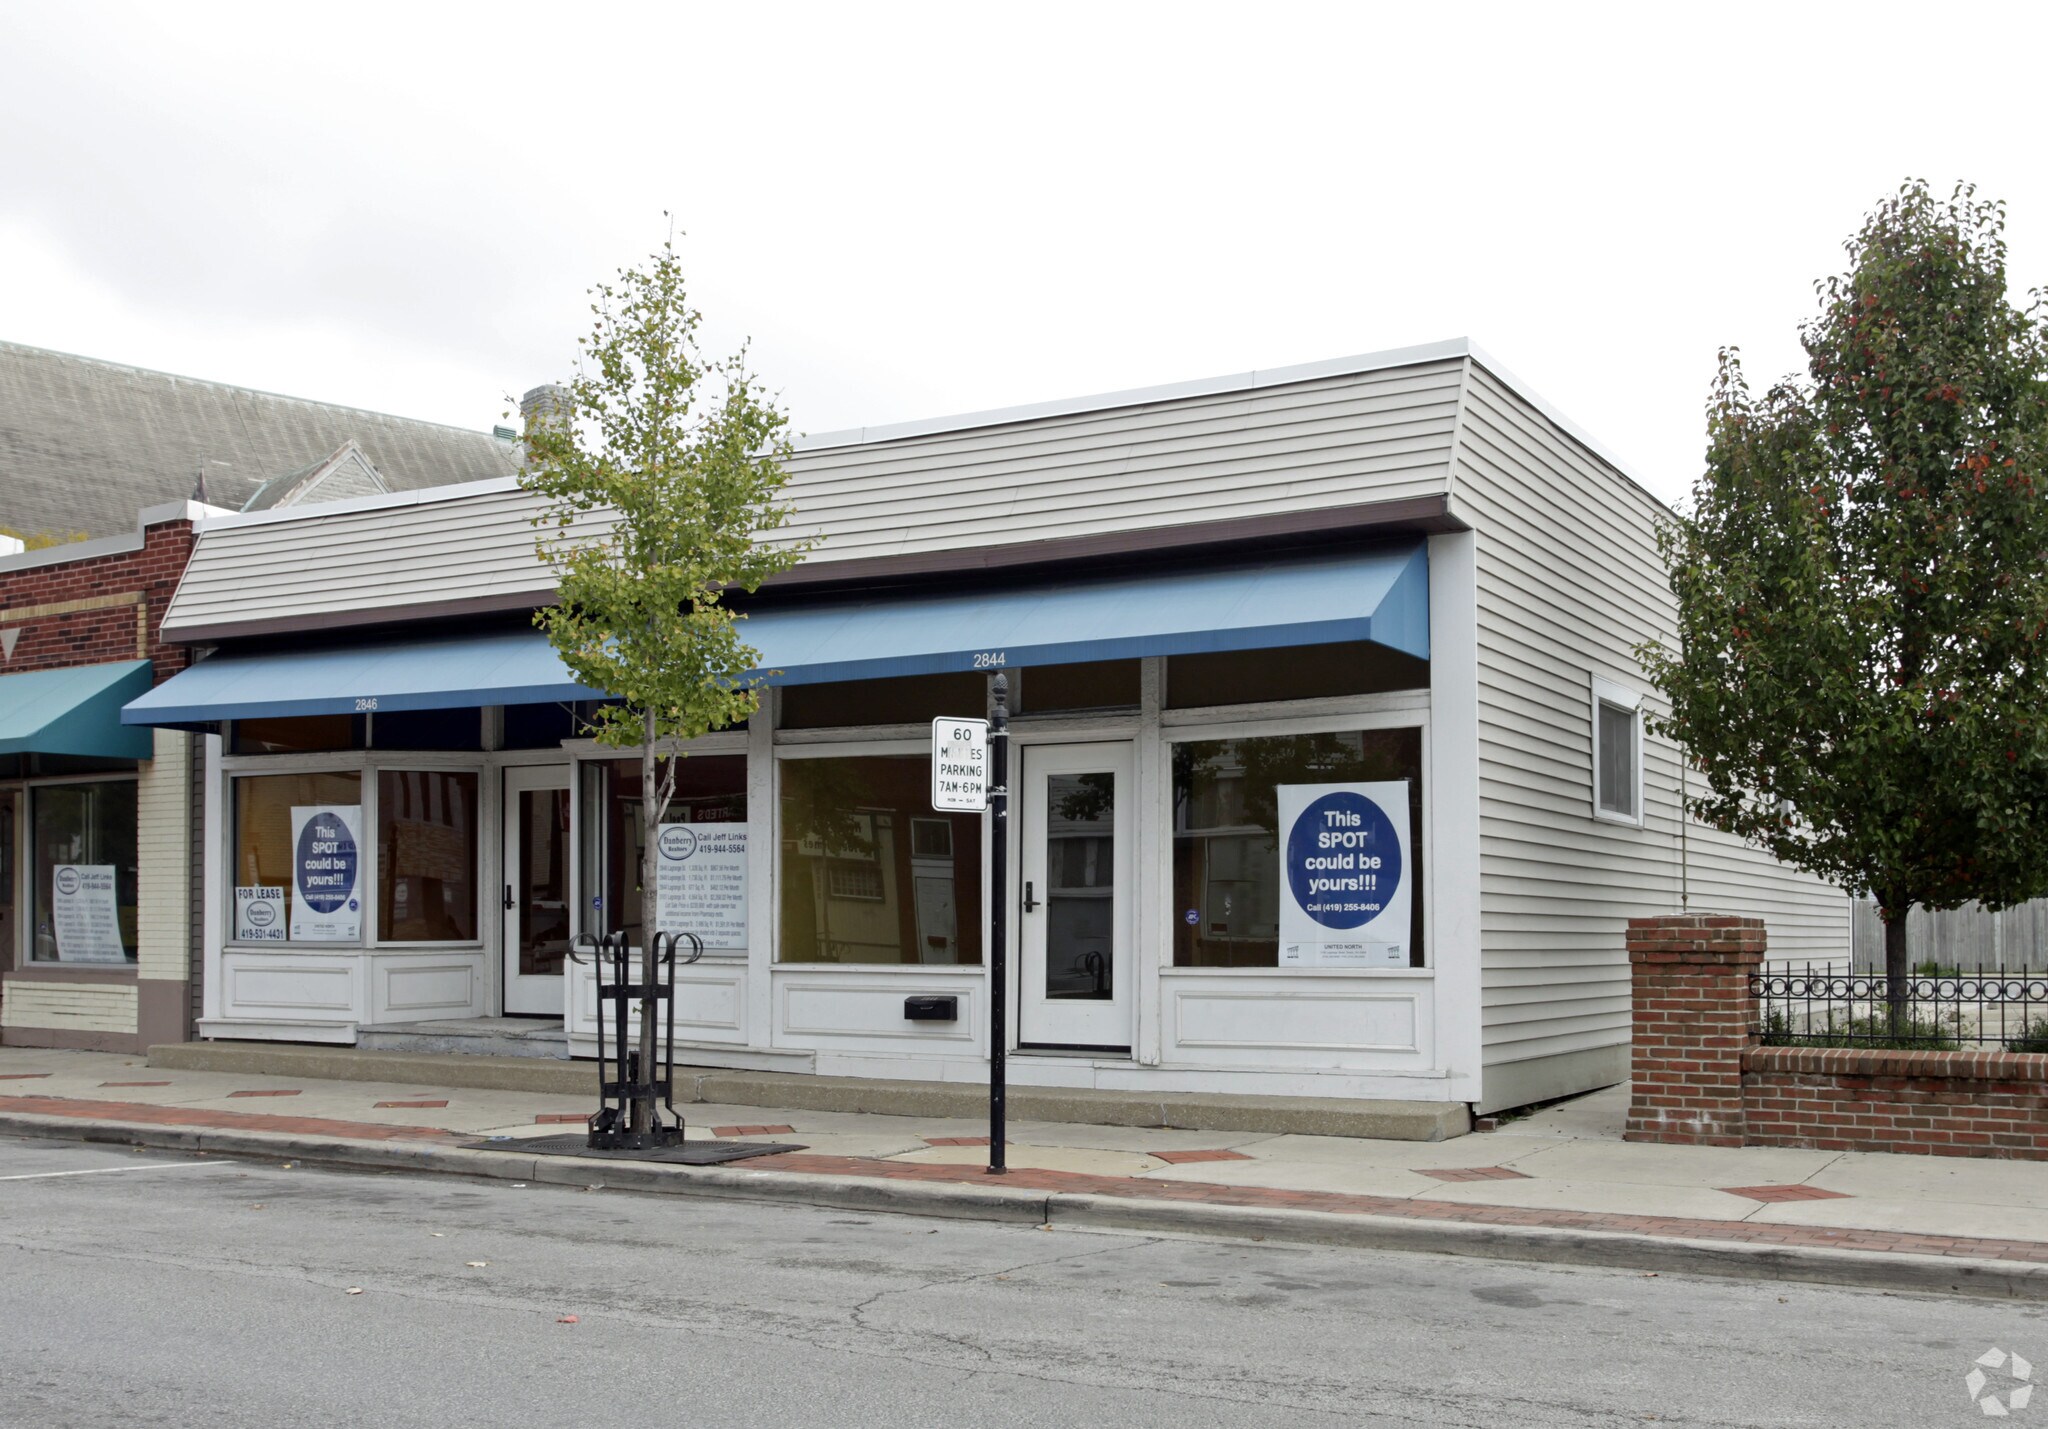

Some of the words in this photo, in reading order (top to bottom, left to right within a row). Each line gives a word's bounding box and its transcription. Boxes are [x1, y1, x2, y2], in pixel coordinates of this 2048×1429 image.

[973, 652, 1006, 668] 2844
[355, 698, 378, 711] 2846
[953, 728, 972, 741] 60
[940, 764, 982, 777] PARKING
[939, 781, 982, 794] 7AM-6PM
[1323, 810, 1361, 827] This
[315, 826, 335, 838] This
[698, 833, 711, 841] Call
[713, 833, 726, 841] Jeff
[728, 833, 747, 841] Links
[1318, 831, 1368, 848] SPOT
[312, 841, 339, 854] SPOT
[699, 844, 745, 853] 419-944-5564
[305, 857, 331, 870] could
[333, 857, 346, 870] be
[1305, 853, 1354, 870] could
[1359, 853, 1381, 869] be
[306, 873, 344, 888] yours!!!
[1308, 874, 1376, 895] yours!!!
[238, 889, 254, 899] FOR
[256, 889, 281, 899] LEASE
[1307, 903, 1321, 911] Call
[1323, 903, 1342, 912] (419)
[1344, 903, 1380, 911] 255-8406
[241, 929, 284, 939] 419-531-4431
